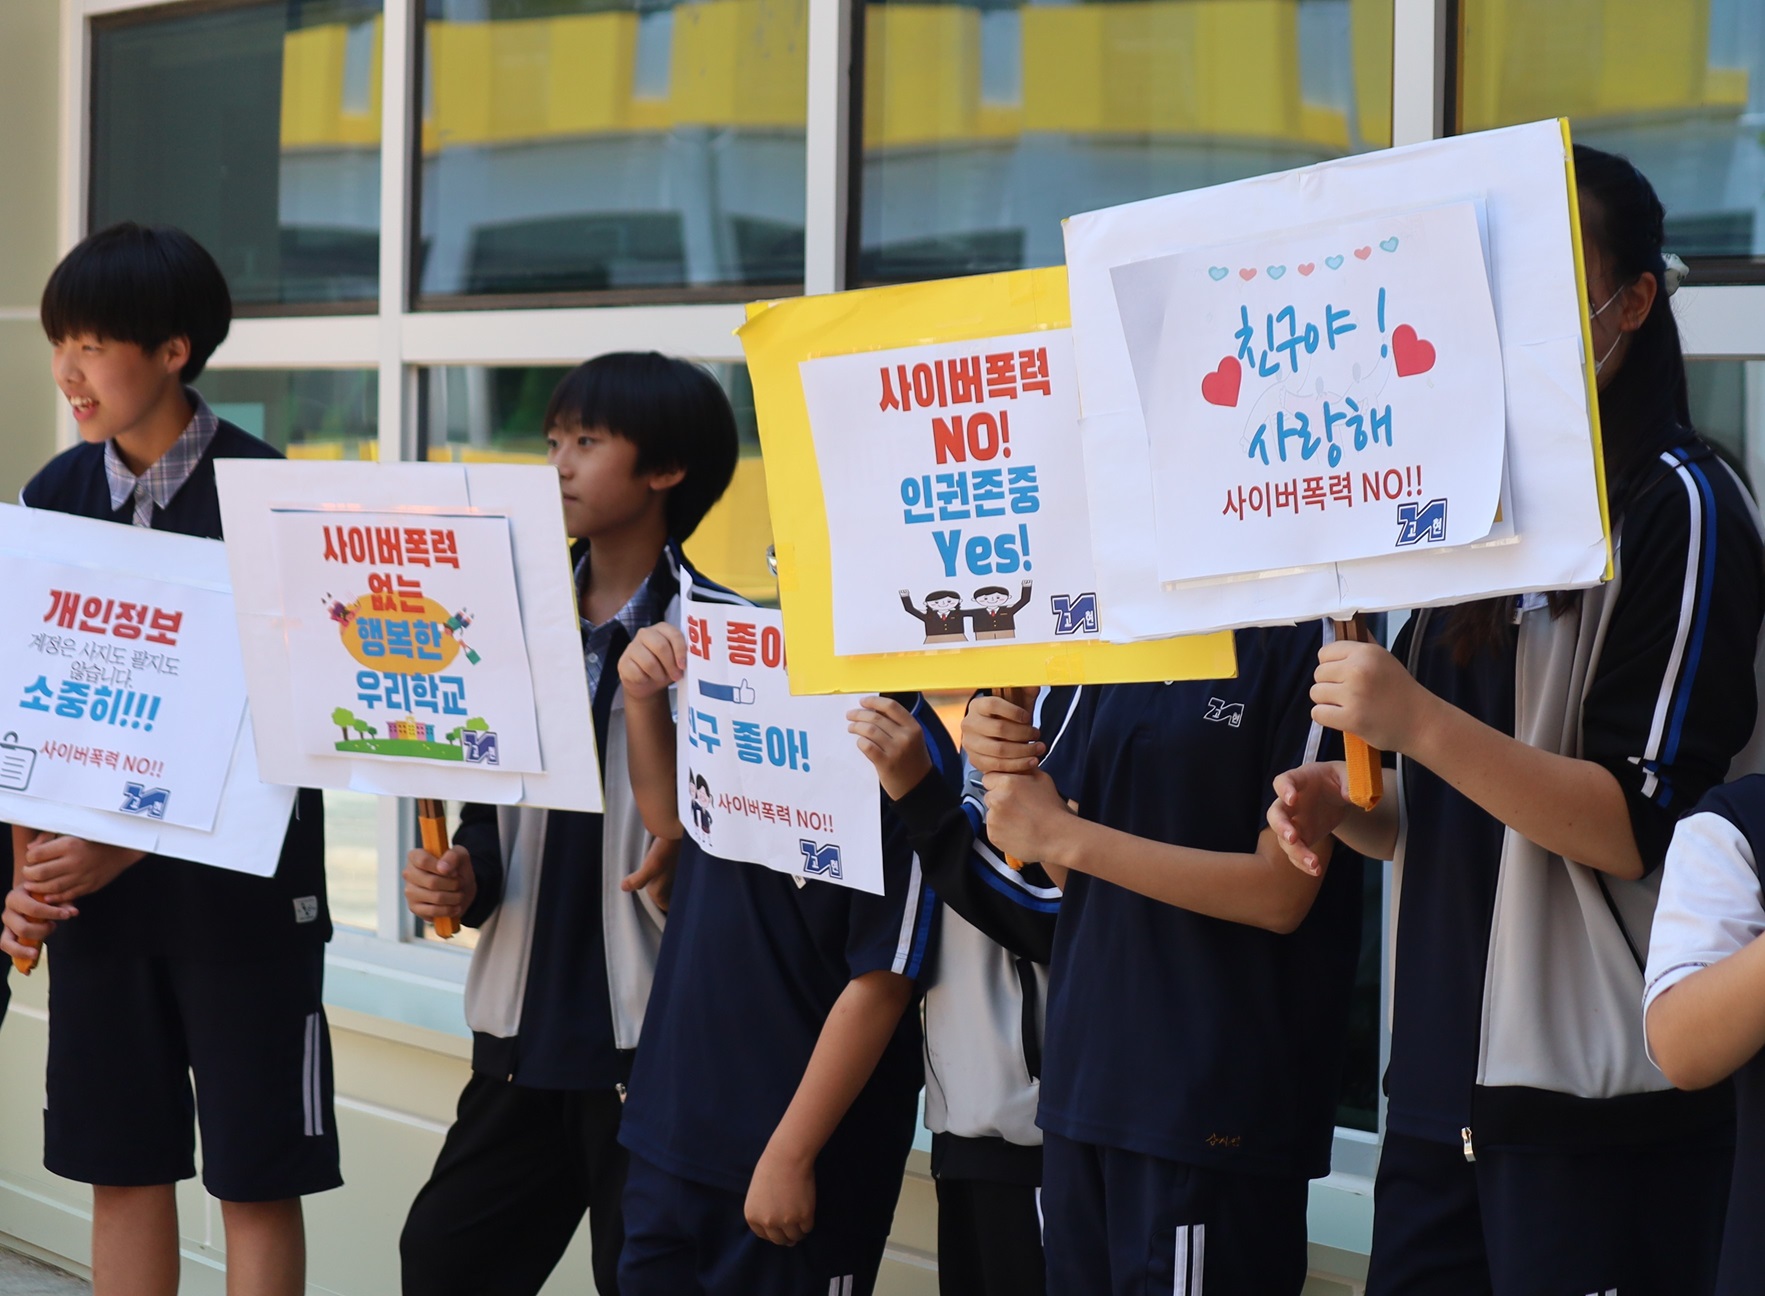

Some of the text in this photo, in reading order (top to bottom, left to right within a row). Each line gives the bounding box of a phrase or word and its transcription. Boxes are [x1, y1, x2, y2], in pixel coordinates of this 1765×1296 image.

[879, 347, 1052, 412] 사이버폭력
[931, 410, 1012, 465] NO!
[1248, 397, 1393, 468] 사랑해
[901, 465, 1040, 525] 인권존중
[1222, 465, 1423, 520] 사이버폭력 NO!!
[322, 525, 460, 569] 사이버폭력
[932, 523, 1032, 578] Yes!
[43, 589, 183, 646] 개인정보
[368, 573, 425, 614] 없는
[28, 632, 181, 677] 계정은 사지도 팔지도
[356, 617, 442, 661] 행복한
[70, 660, 134, 690] 않습니다.
[356, 670, 468, 716] 우리학교
[18, 674, 162, 733] 소중히!!!
[40, 740, 164, 779] 사이버폭력 NO!!
[732, 720, 811, 773] 좋아!
[718, 792, 835, 834] 사이버폭력 NO!!
